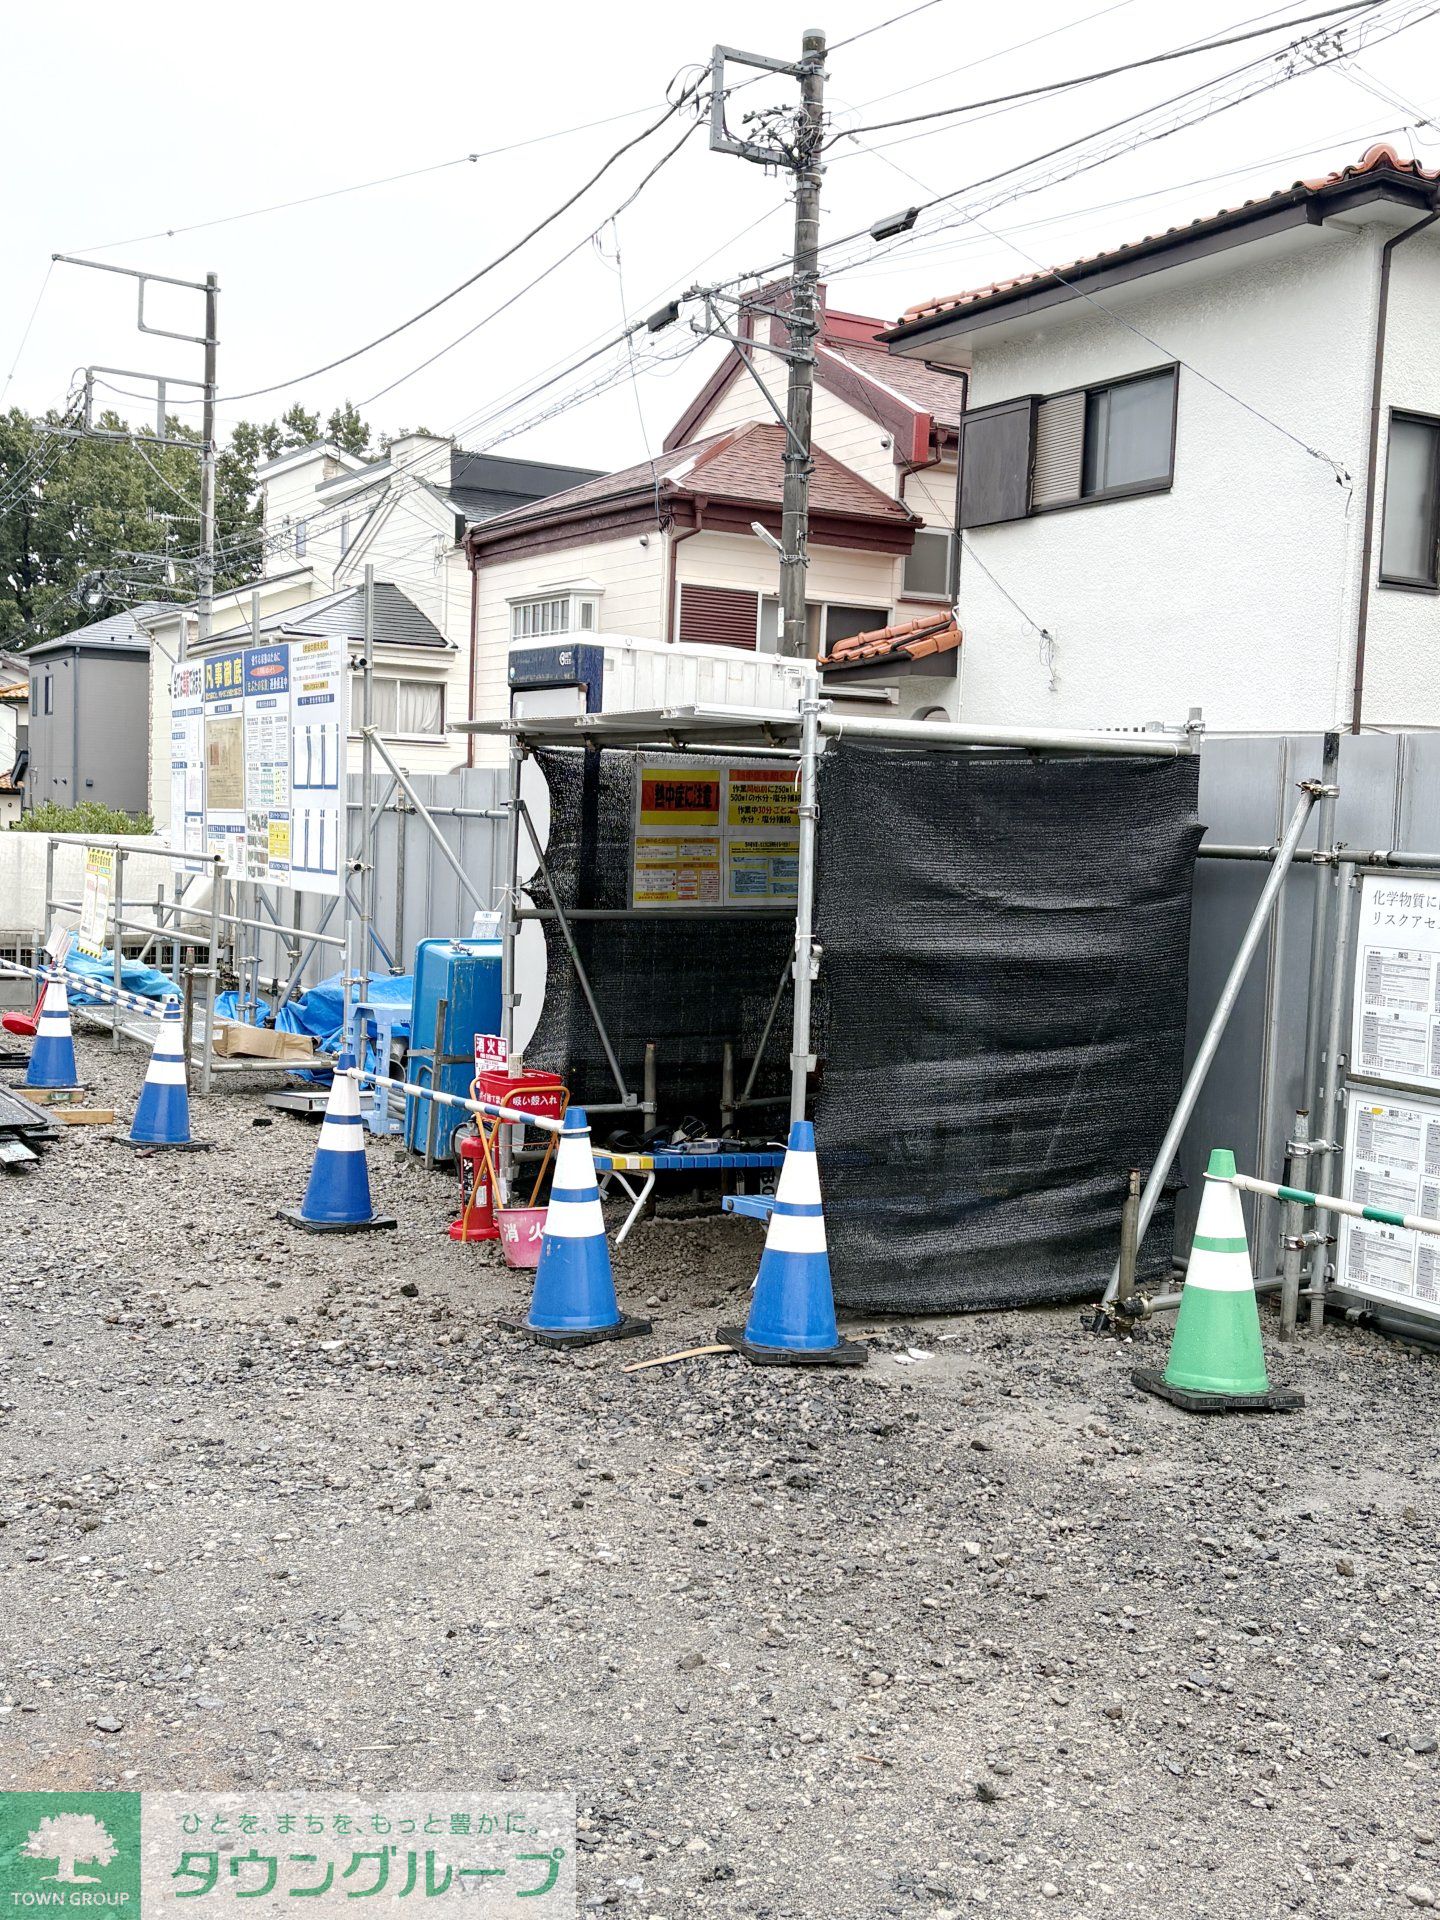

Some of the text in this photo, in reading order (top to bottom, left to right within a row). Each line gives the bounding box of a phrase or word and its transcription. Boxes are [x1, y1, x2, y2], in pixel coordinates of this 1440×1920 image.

[1373, 889, 1440, 910] 化学物質に
[1373, 911, 1440, 929] リスクアセ
[476, 1037, 506, 1057] 消火器
[512, 1095, 557, 1106] 吸い殻入れ
